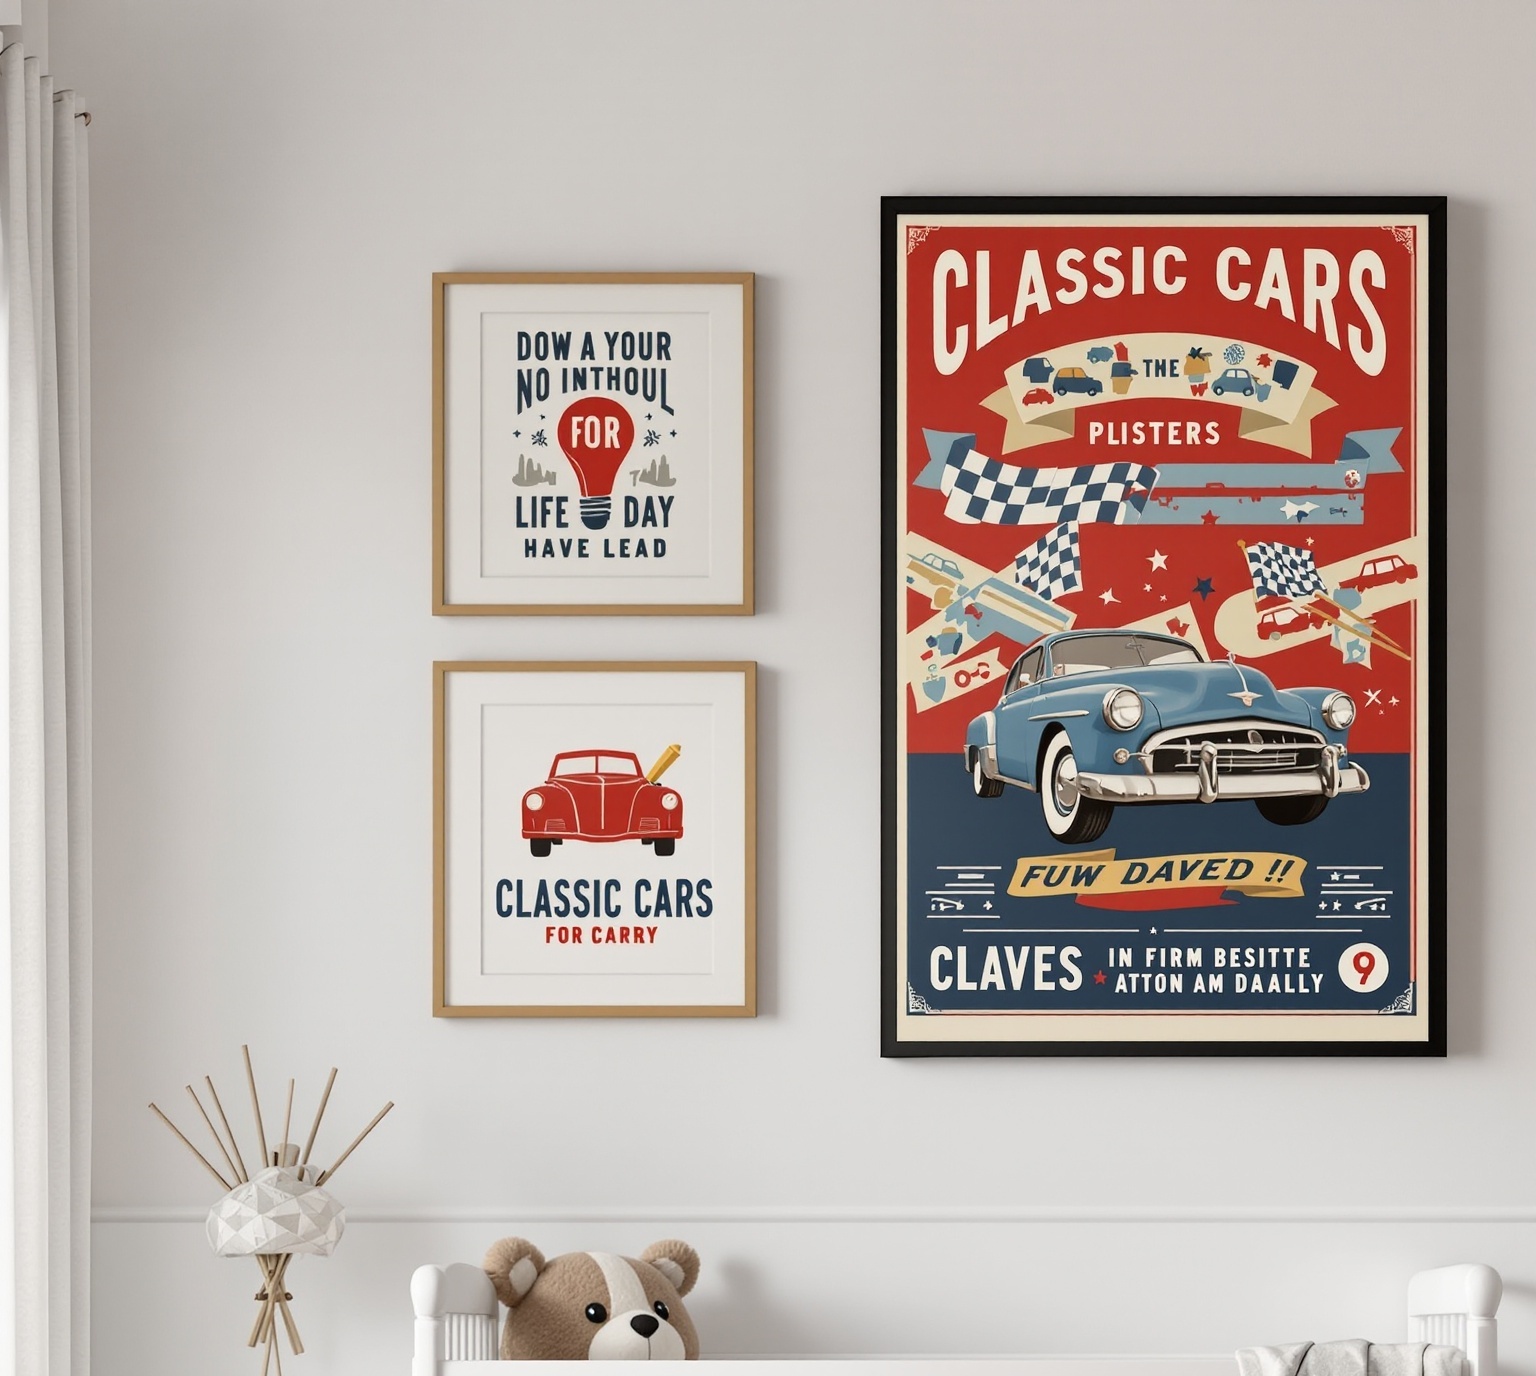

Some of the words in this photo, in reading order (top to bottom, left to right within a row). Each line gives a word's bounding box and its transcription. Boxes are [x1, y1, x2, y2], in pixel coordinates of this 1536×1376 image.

[932, 245, 1188, 376] CLASSIC
[1215, 245, 1388, 377] CARS
[517, 331, 571, 361] DOW
[580, 331, 596, 361] A
[604, 331, 672, 361] YOUR
[1142, 358, 1180, 379] THE
[516, 367, 550, 415] NO
[561, 366, 675, 416] INTHOUL
[571, 415, 621, 449] FOR
[1088, 420, 1222, 447] PLISTERS
[515, 495, 569, 528] LIFE
[624, 495, 675, 528] DAY
[524, 538, 590, 558] HAVE
[603, 538, 667, 558] LEAD
[1019, 863, 1107, 889] FUW
[1120, 857, 1256, 886] DAVED
[496, 878, 622, 918] CLASSIC
[634, 878, 714, 918] CARS
[545, 926, 583, 944] FOR
[591, 926, 658, 944] CARRY
[929, 944, 1084, 992] CLAVES
[1108, 947, 1134, 968] IN
[1145, 947, 1203, 968] FIRM
[1213, 947, 1311, 968] BESITTE
[1352, 950, 1377, 986] 9
[1114, 973, 1184, 994] ATTON
[1193, 973, 1225, 994] AM
[1235, 973, 1324, 995] DAALLY
